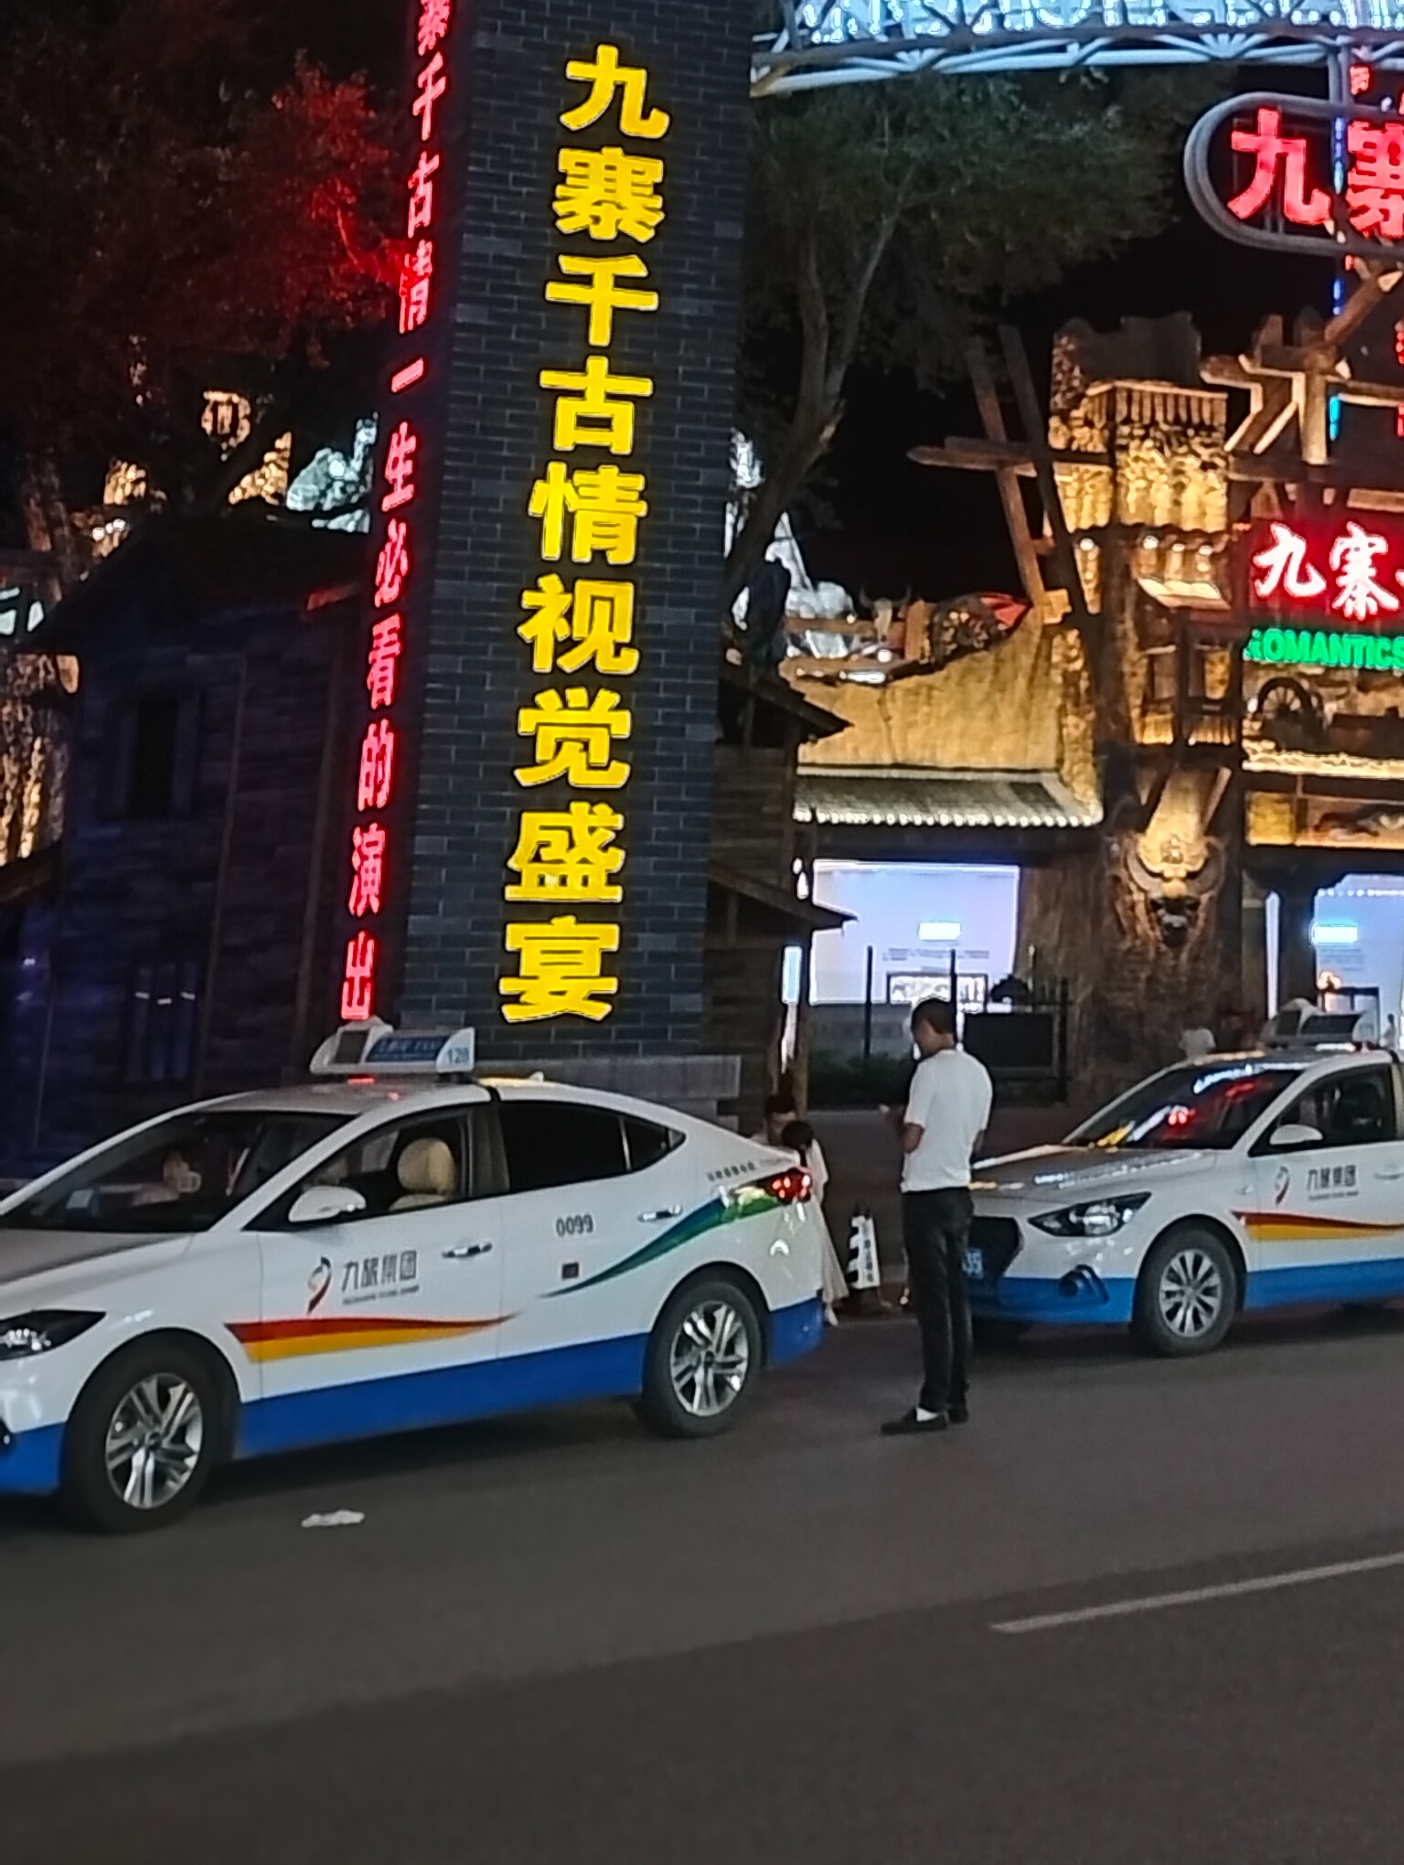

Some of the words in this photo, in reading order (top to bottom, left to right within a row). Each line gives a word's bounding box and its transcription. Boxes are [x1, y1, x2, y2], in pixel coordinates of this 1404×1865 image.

[498, 43, 669, 1022] 九寨千古情视觉盛宴
[556, 1214, 594, 1237] 0099
